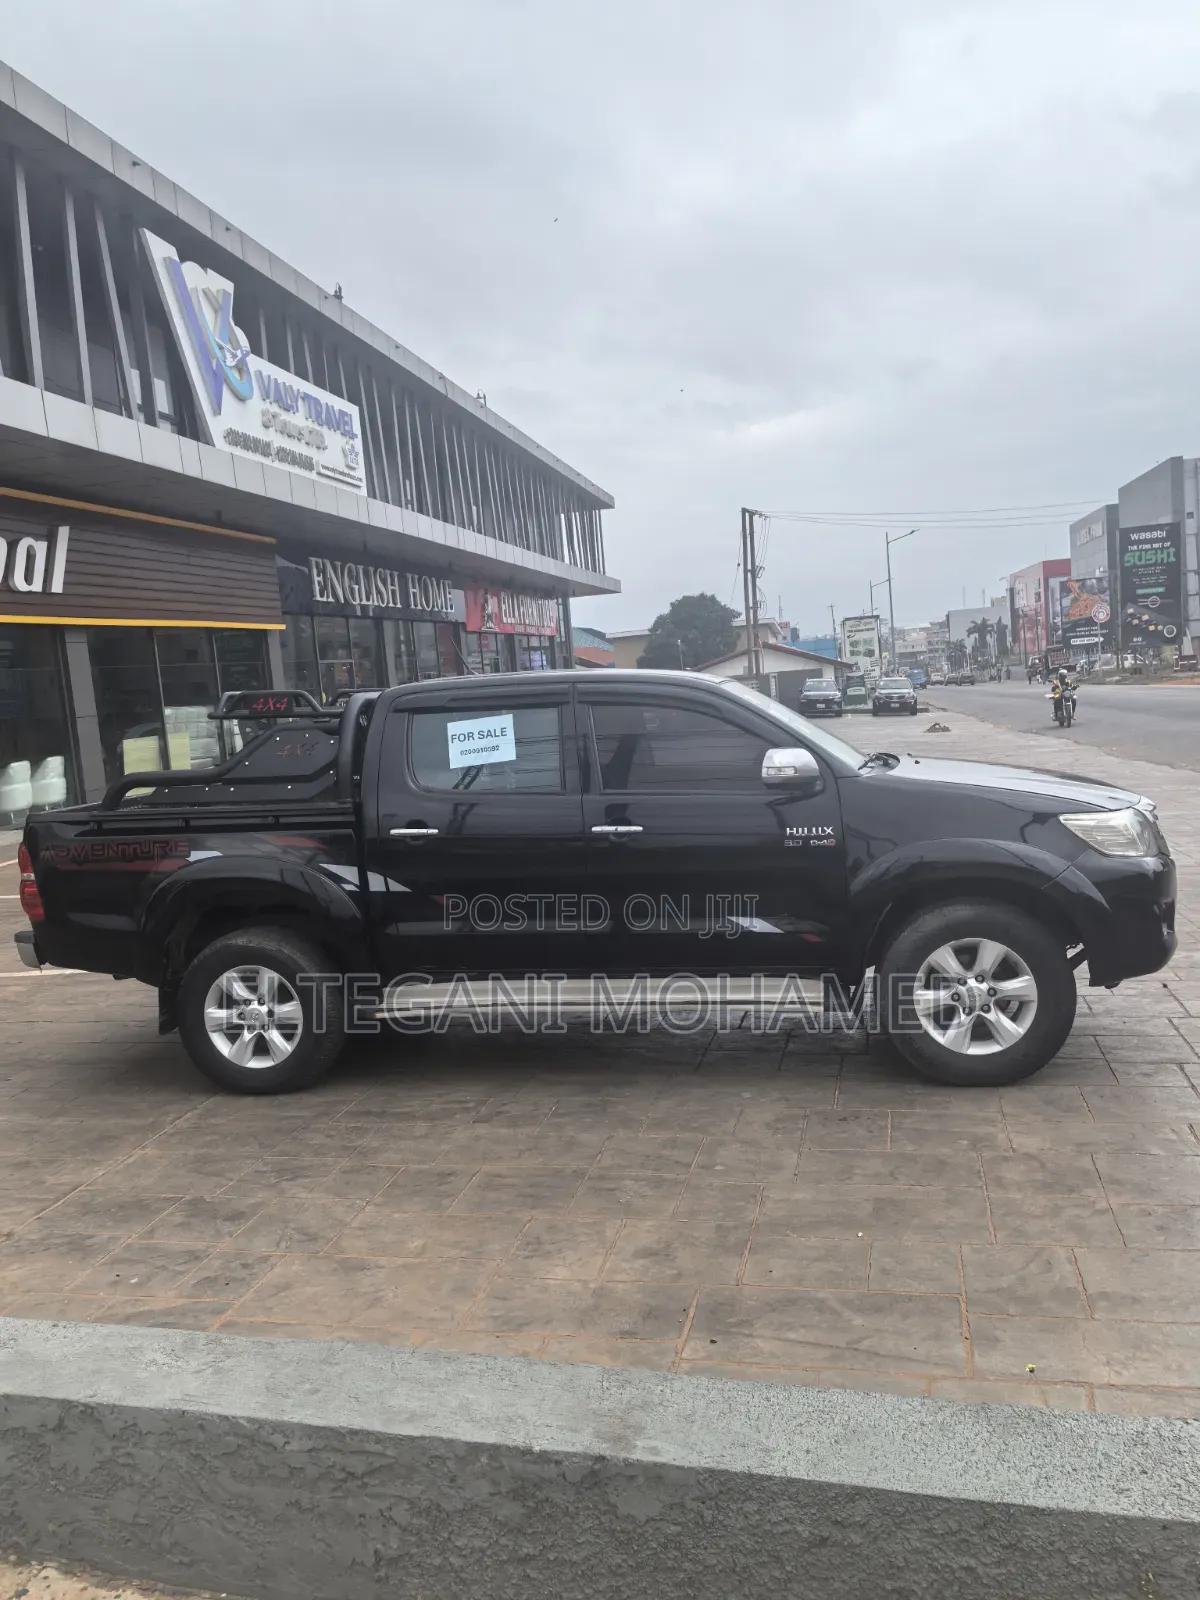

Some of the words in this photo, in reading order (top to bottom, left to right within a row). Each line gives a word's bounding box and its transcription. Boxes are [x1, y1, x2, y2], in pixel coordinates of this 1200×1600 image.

[254, 369, 300, 415] VALY
[300, 391, 359, 440] TRAVEL
[1130, 530, 1167, 541] wasabi
[1124, 547, 1176, 567] SUSHI
[308, 556, 403, 608] ENGLISH
[406, 572, 455, 613] HOME
[252, 696, 289, 712] 4X4
[451, 731, 476, 744] FOR
[477, 726, 508, 740] SALE
[786, 826, 834, 836] HILUX
